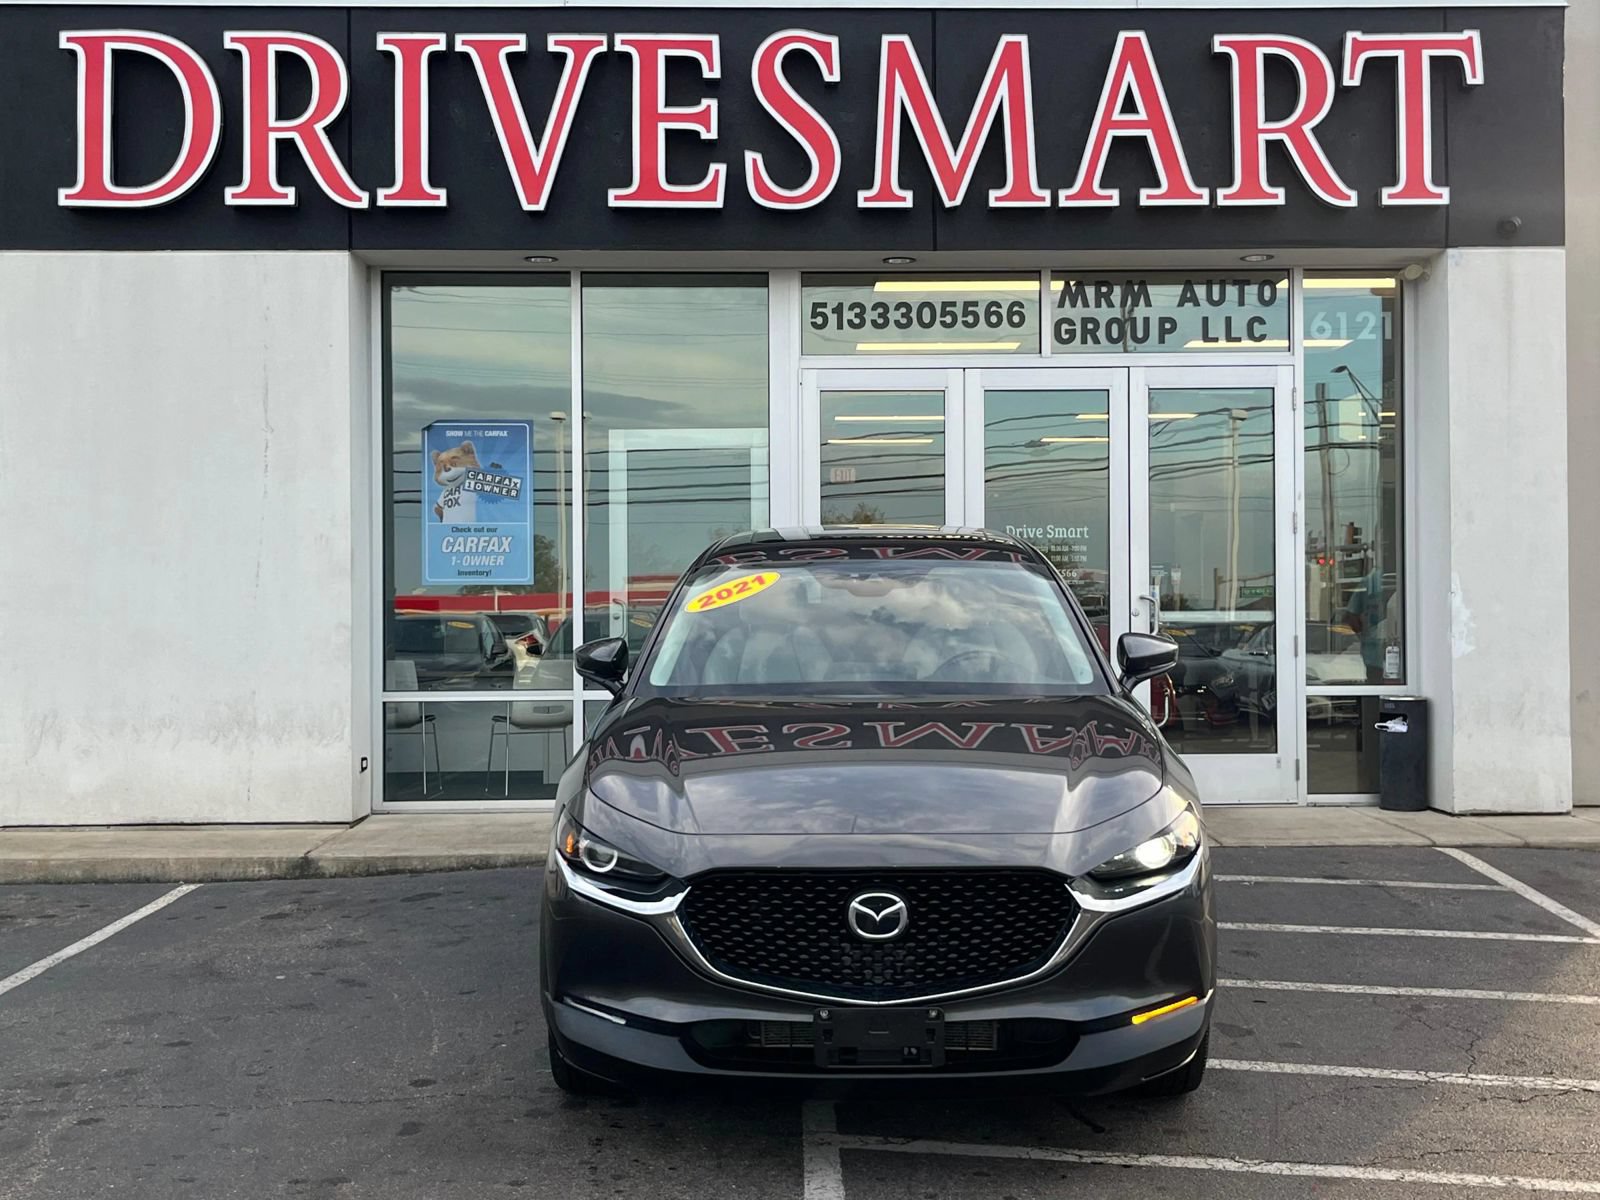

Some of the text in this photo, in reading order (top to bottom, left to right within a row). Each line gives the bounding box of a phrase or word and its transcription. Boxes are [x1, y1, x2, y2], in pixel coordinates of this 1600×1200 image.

[1057, 279, 1278, 308] MRM AUTO
[810, 300, 1026, 330] 5133305566
[1054, 316, 1268, 345] GROUP LLC
[1310, 311, 1392, 340] 6121
[467, 470, 520, 489] CARFAX
[443, 486, 461, 499] CAR
[443, 497, 461, 509] FOX
[1005, 525, 1089, 539] Drive Smart
[441, 536, 513, 553] CARFAX
[457, 569, 492, 577] Inventory!
[697, 575, 767, 609] 2021
